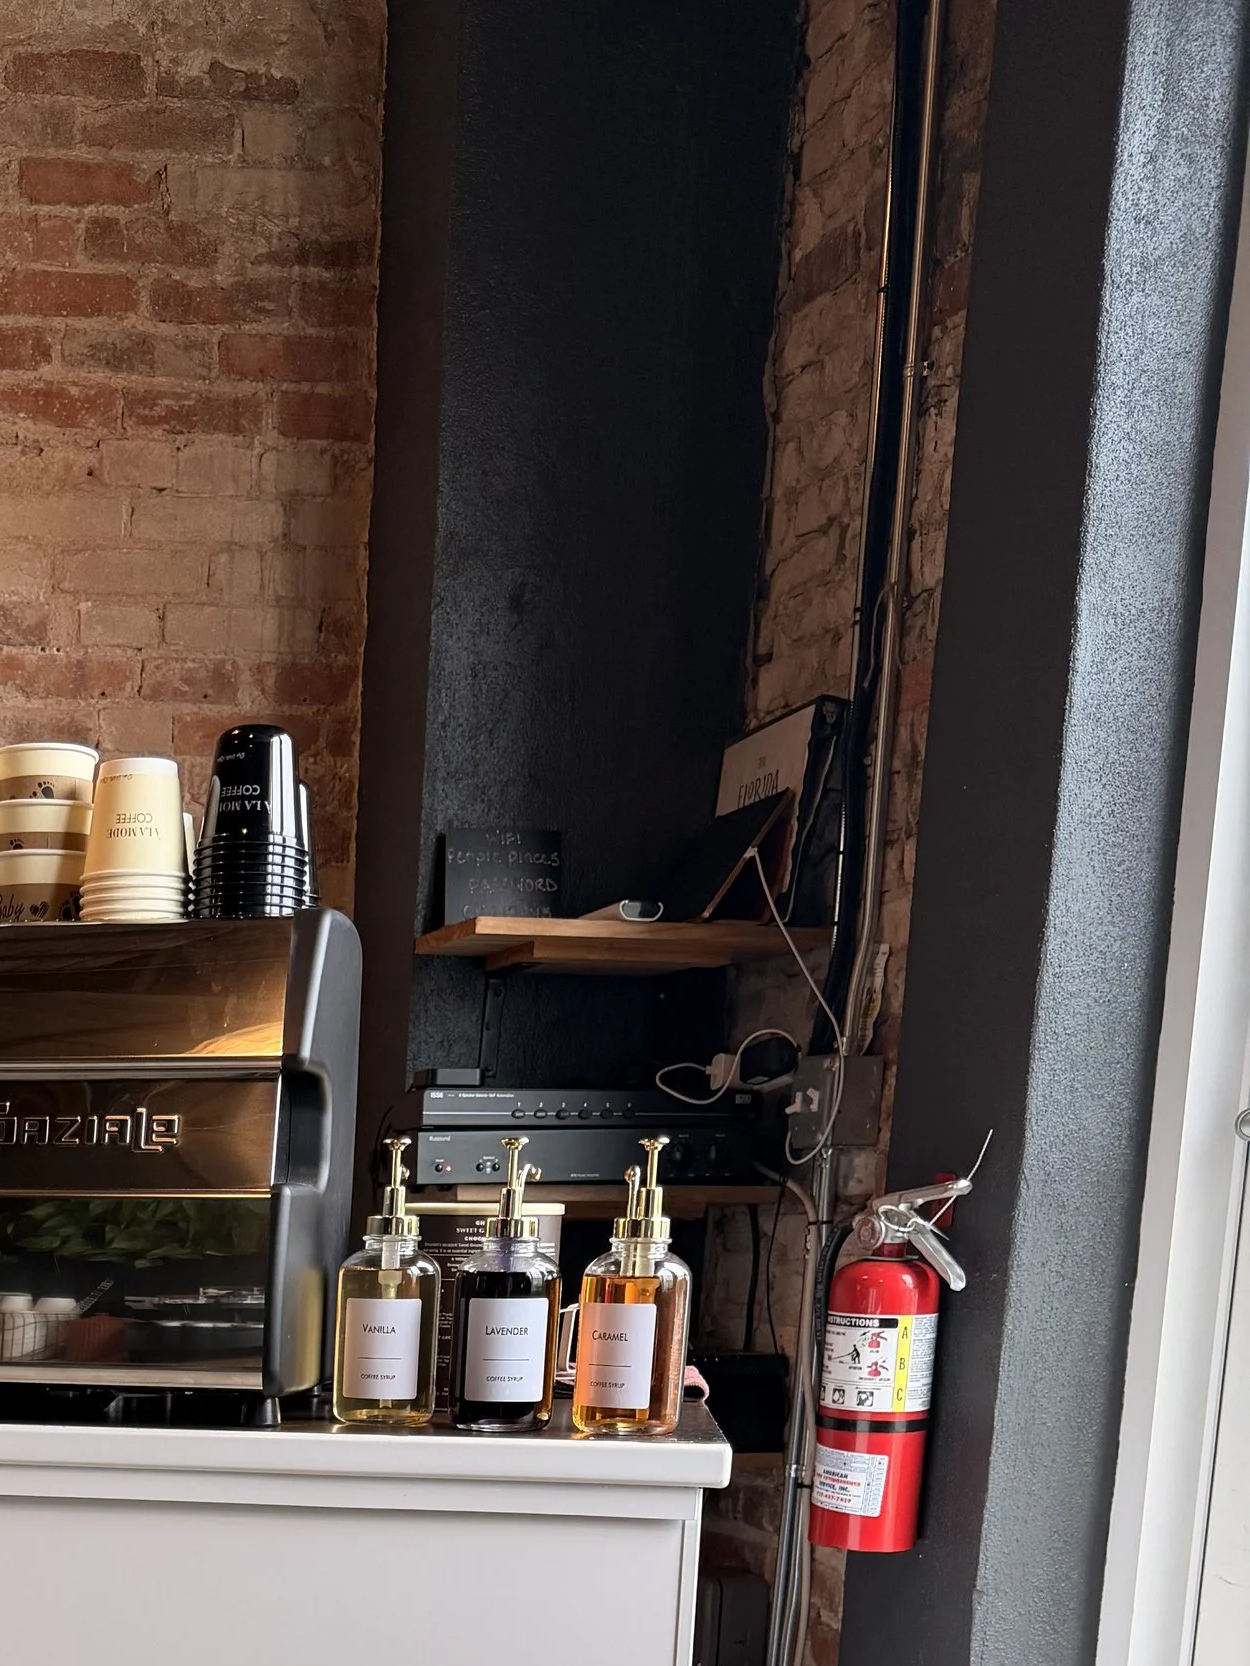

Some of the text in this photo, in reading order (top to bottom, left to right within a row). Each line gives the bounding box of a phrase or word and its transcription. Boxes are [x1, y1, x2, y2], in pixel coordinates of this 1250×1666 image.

[221, 784, 260, 797] COFFEE
[116, 812, 153, 824] COFFEE
[107, 827, 138, 838] MODE
[902, 1326, 908, 1340] A
[899, 1358, 905, 1370] B
[896, 1388, 903, 1401] C
